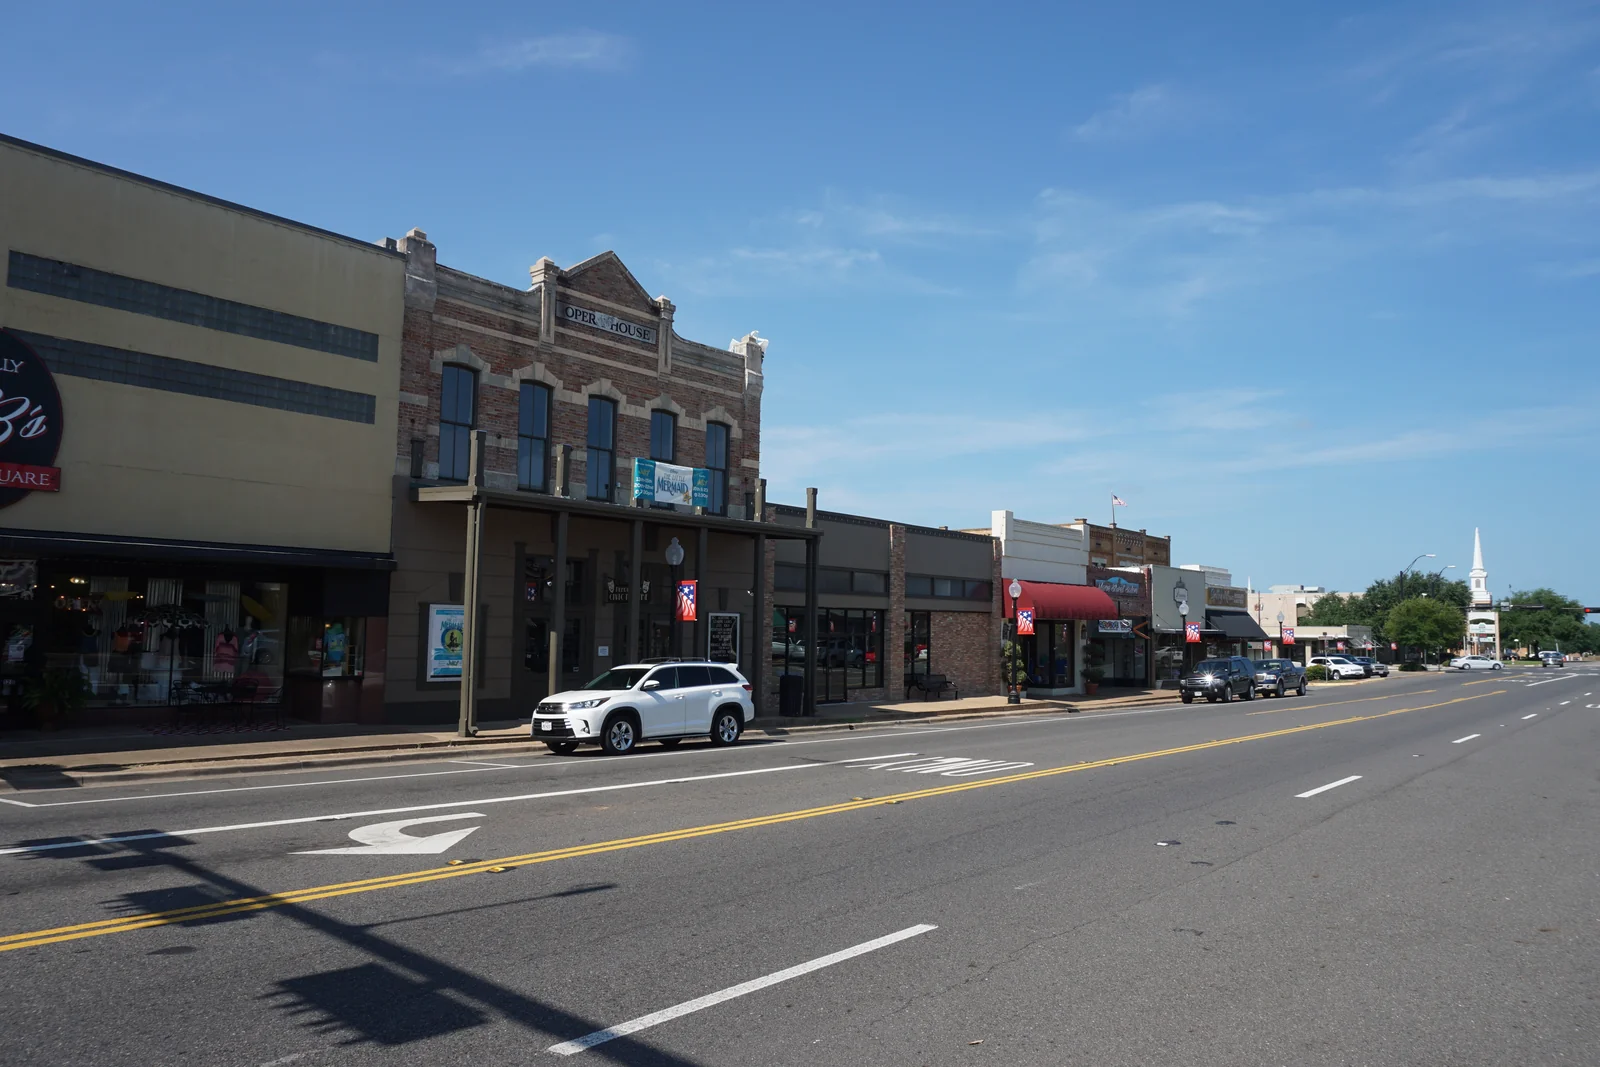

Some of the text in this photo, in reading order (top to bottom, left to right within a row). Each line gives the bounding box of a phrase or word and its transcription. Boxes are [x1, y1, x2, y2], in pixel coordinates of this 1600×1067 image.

[610, 321, 650, 341] HOUSE
[656, 478, 688, 496] MERMAID
[609, 593, 623, 601] CIVIC
[845, 757, 1034, 776] ONLY
